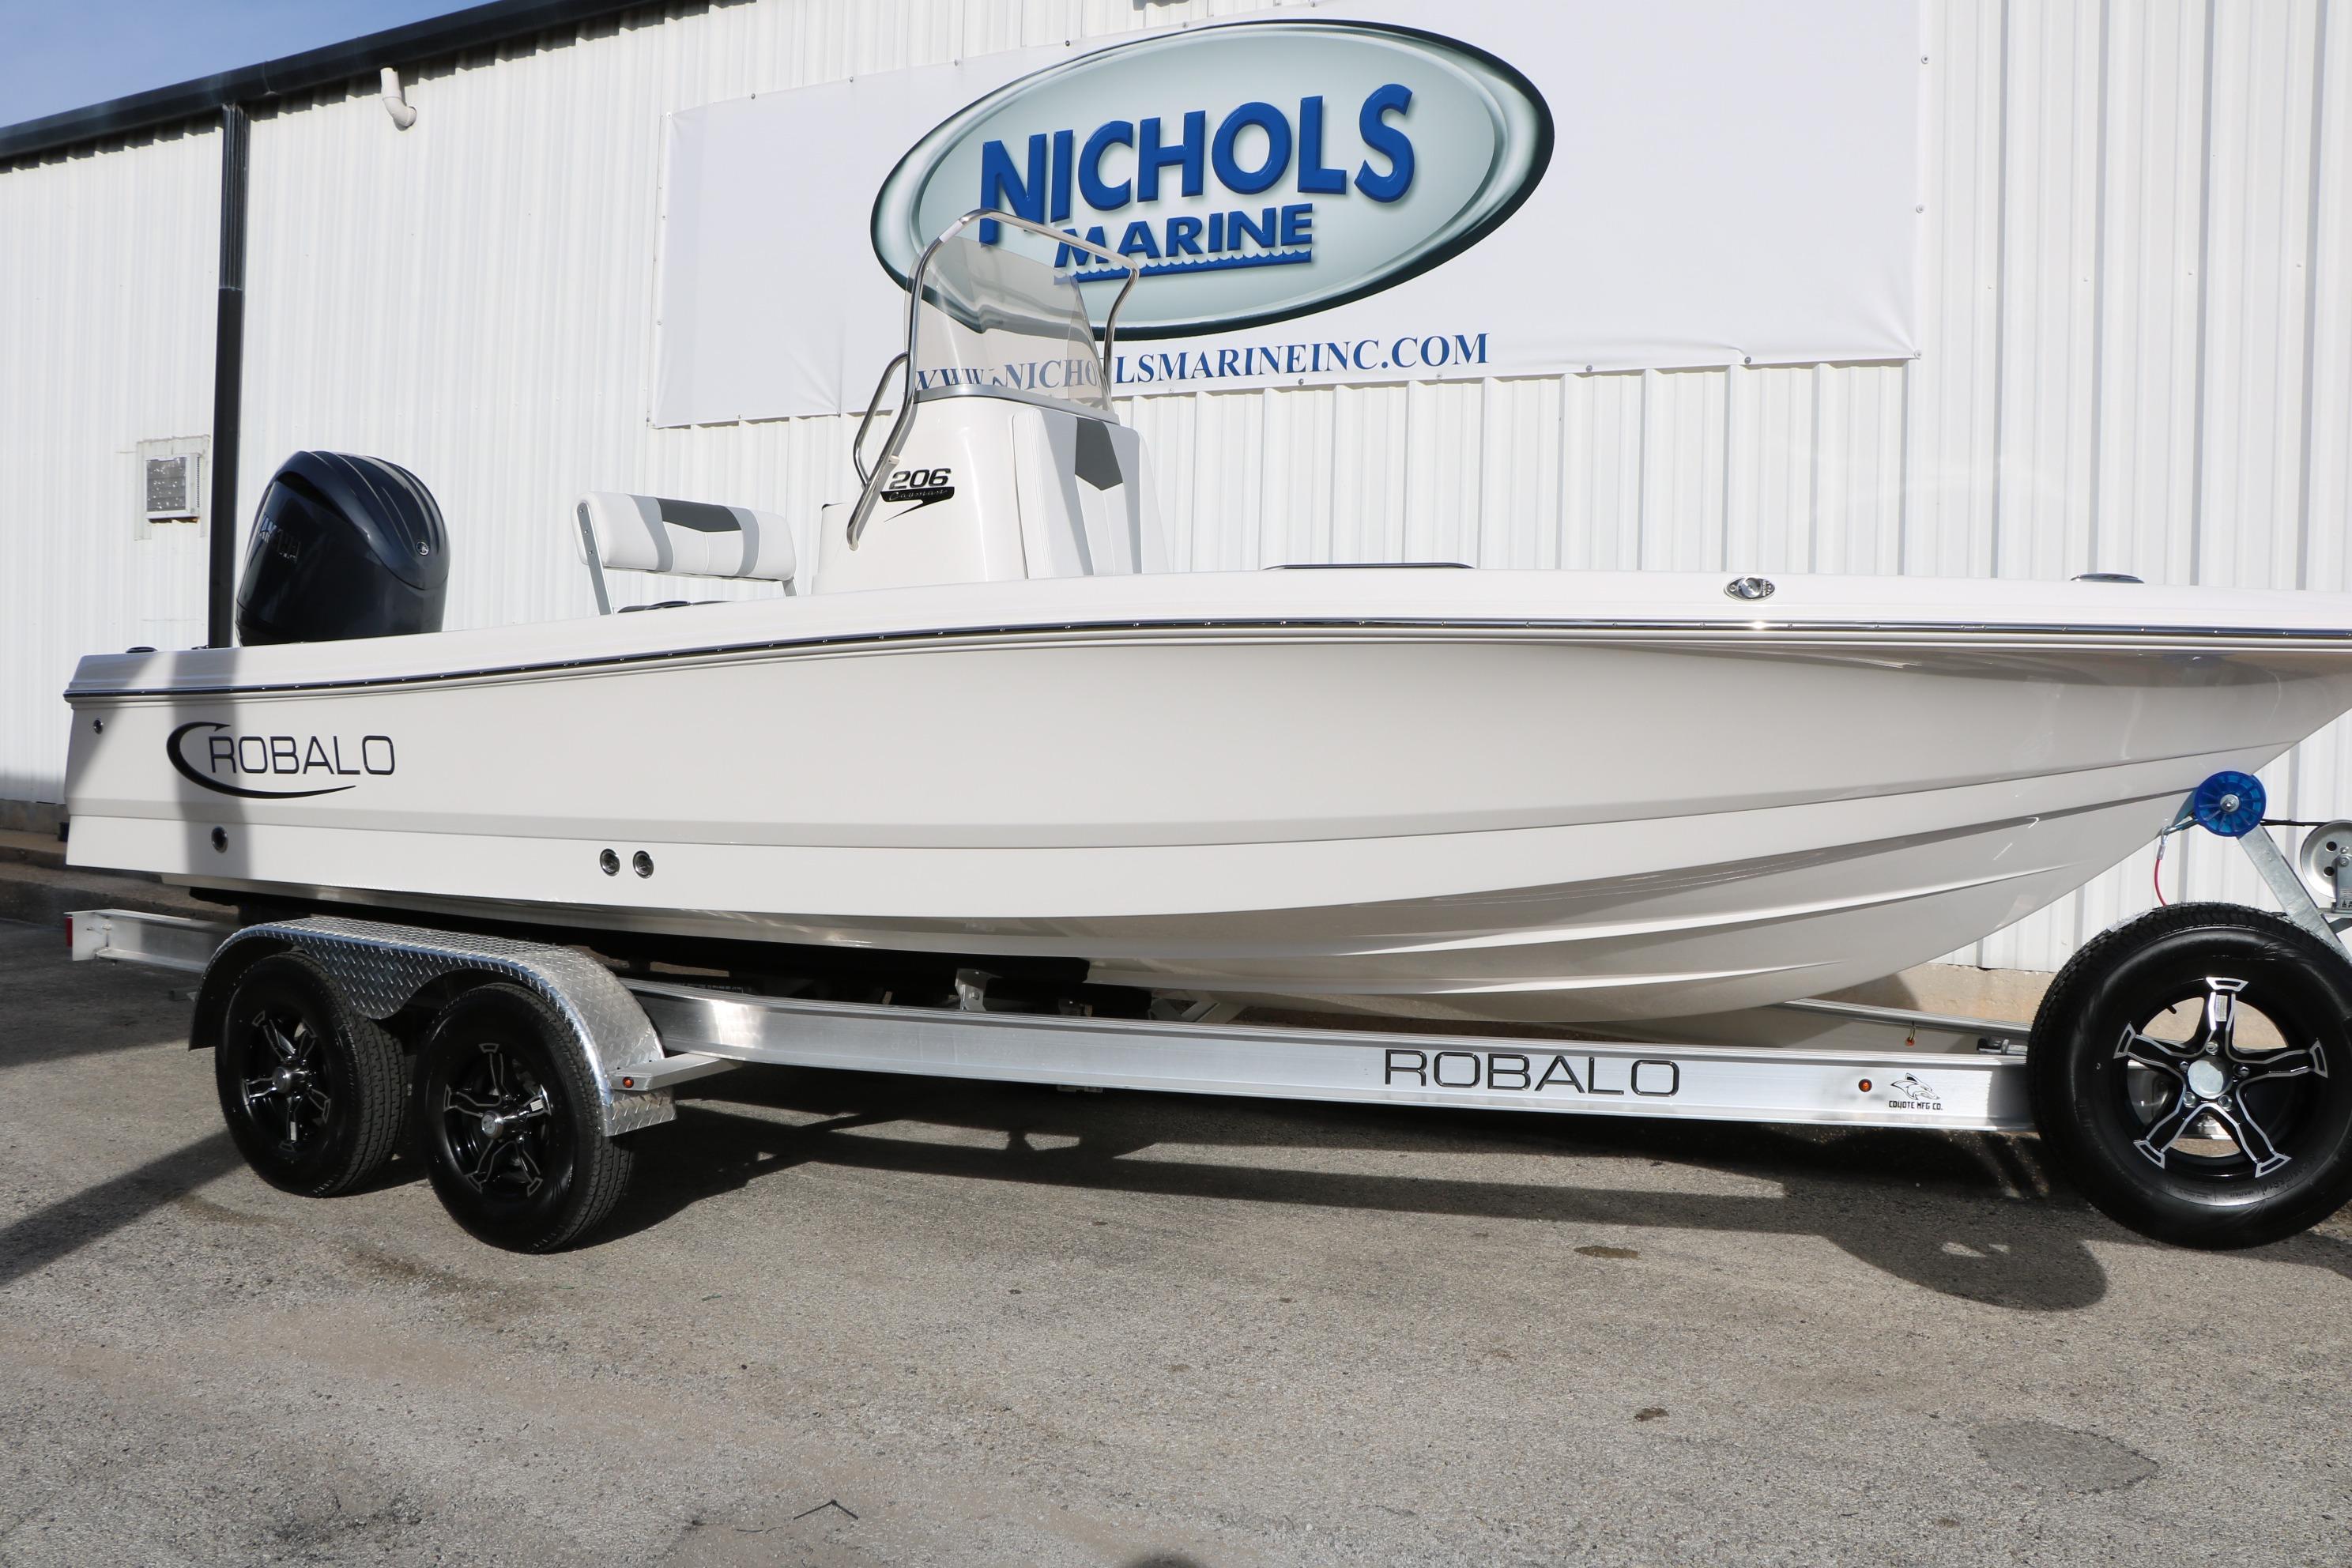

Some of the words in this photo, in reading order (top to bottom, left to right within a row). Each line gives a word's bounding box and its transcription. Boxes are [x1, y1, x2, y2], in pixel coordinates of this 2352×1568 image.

[978, 84, 1415, 246] NICHOLS
[1054, 202, 1313, 269] MARINE
[914, 333, 1488, 392] WWWNICHOLSMARINEINC.COM
[889, 468, 952, 490] 206
[209, 735, 395, 775] ROBALO
[1385, 1049, 1679, 1097] ROBALO
[1889, 1100, 1915, 1110] COYOTE
